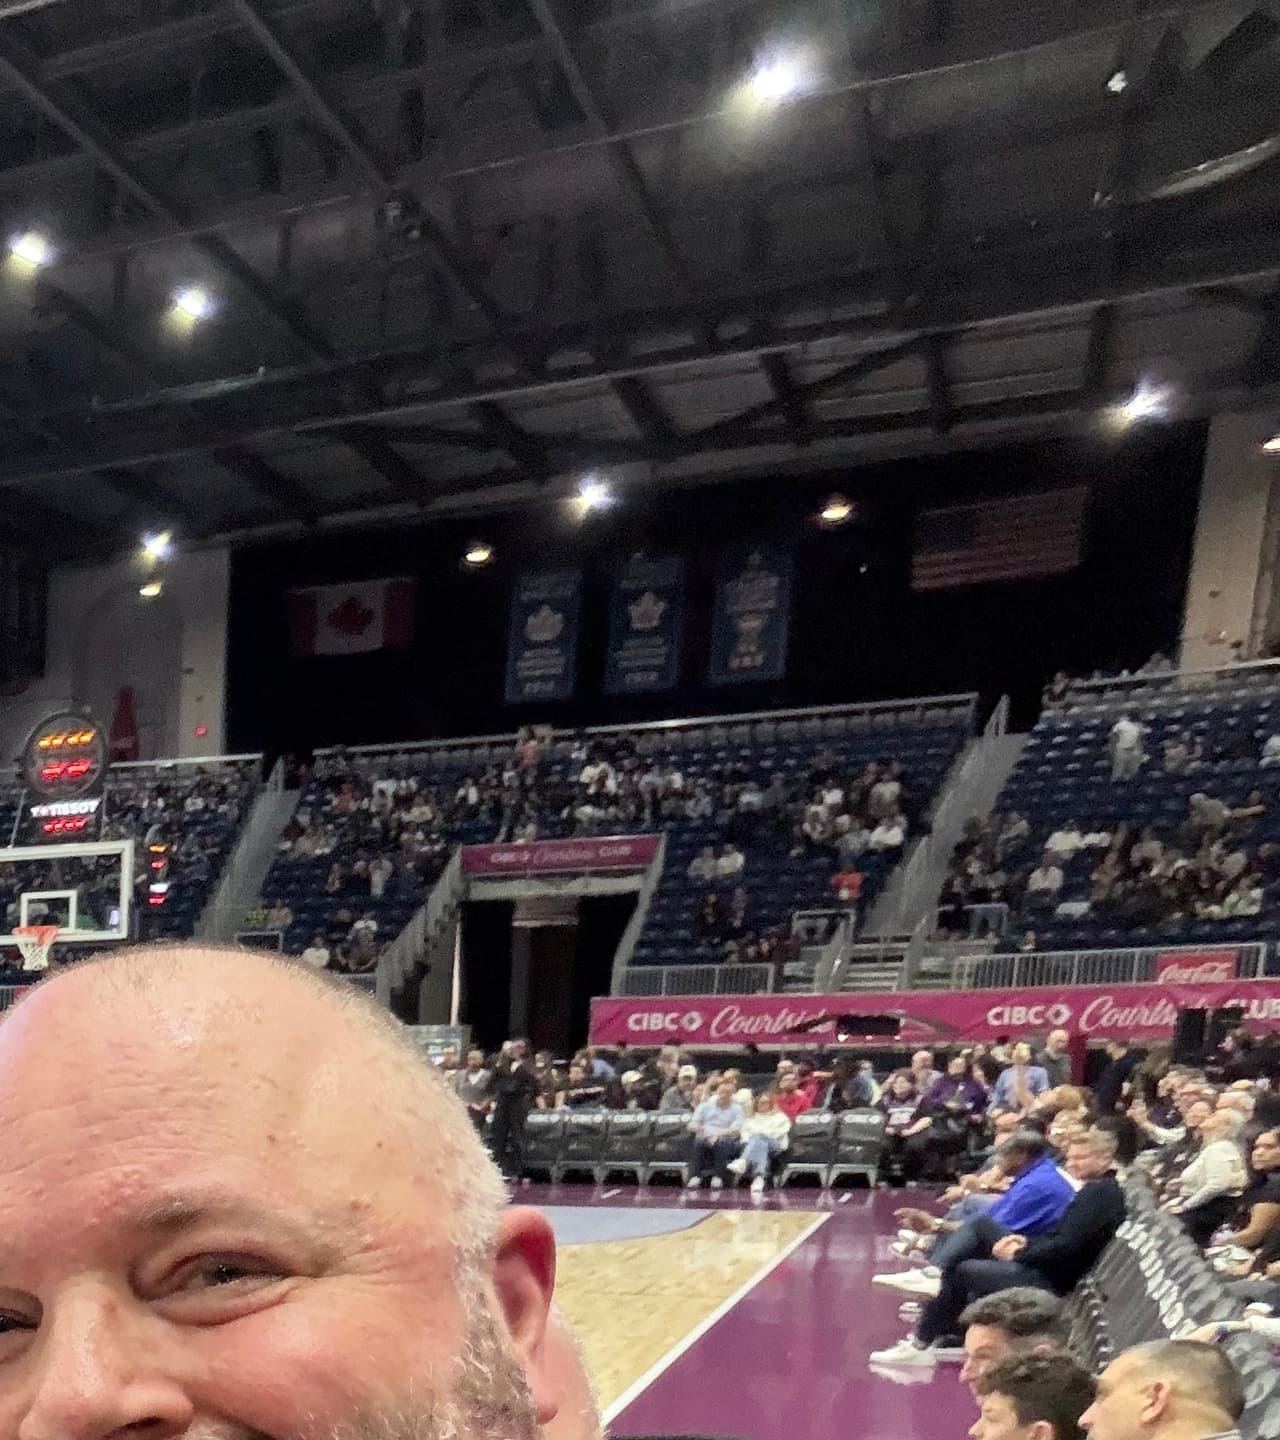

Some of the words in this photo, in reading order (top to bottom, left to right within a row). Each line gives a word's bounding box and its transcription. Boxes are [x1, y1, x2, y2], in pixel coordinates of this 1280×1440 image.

[627, 1011, 679, 1033] CIBC
[986, 1006, 1046, 1027] CIBC
[1078, 995, 1178, 1032] Courts
